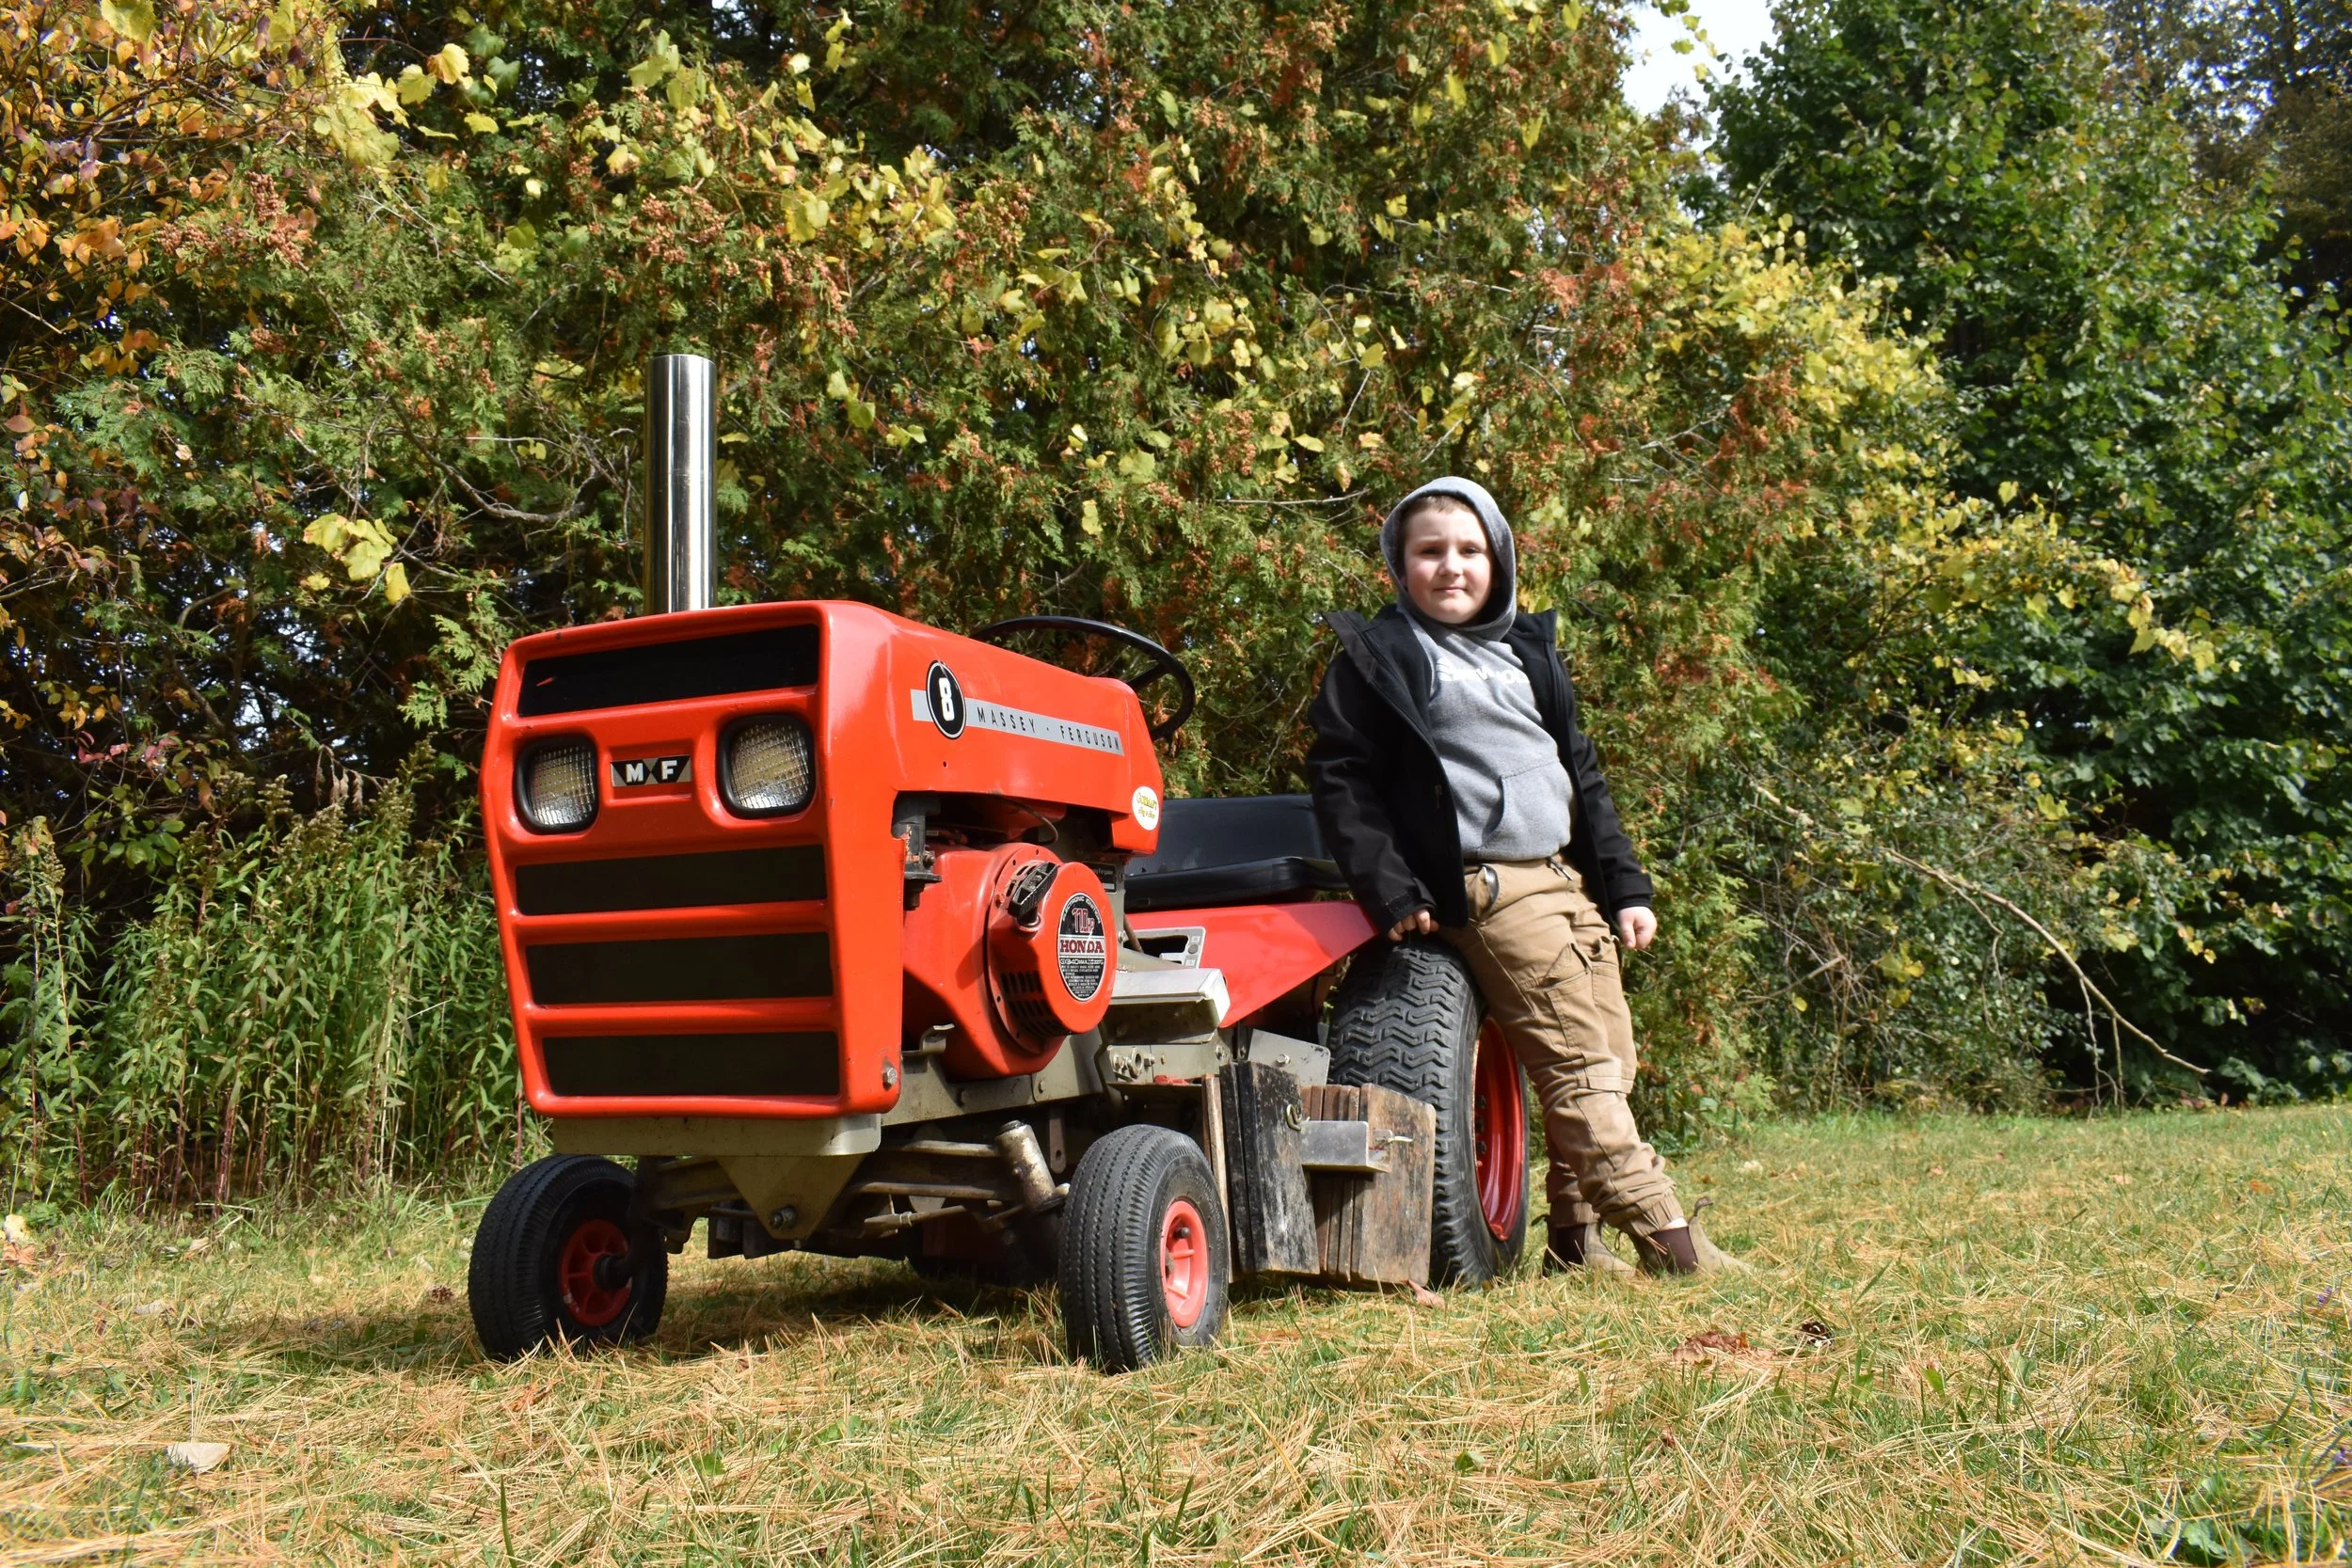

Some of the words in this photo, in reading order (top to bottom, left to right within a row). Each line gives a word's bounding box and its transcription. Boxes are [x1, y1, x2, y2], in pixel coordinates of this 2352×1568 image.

[938, 677, 955, 721] 8
[977, 706, 1036, 734] MASSEY
[1059, 725, 1120, 751] FERGUSON
[1059, 940, 1104, 953] HONDA
